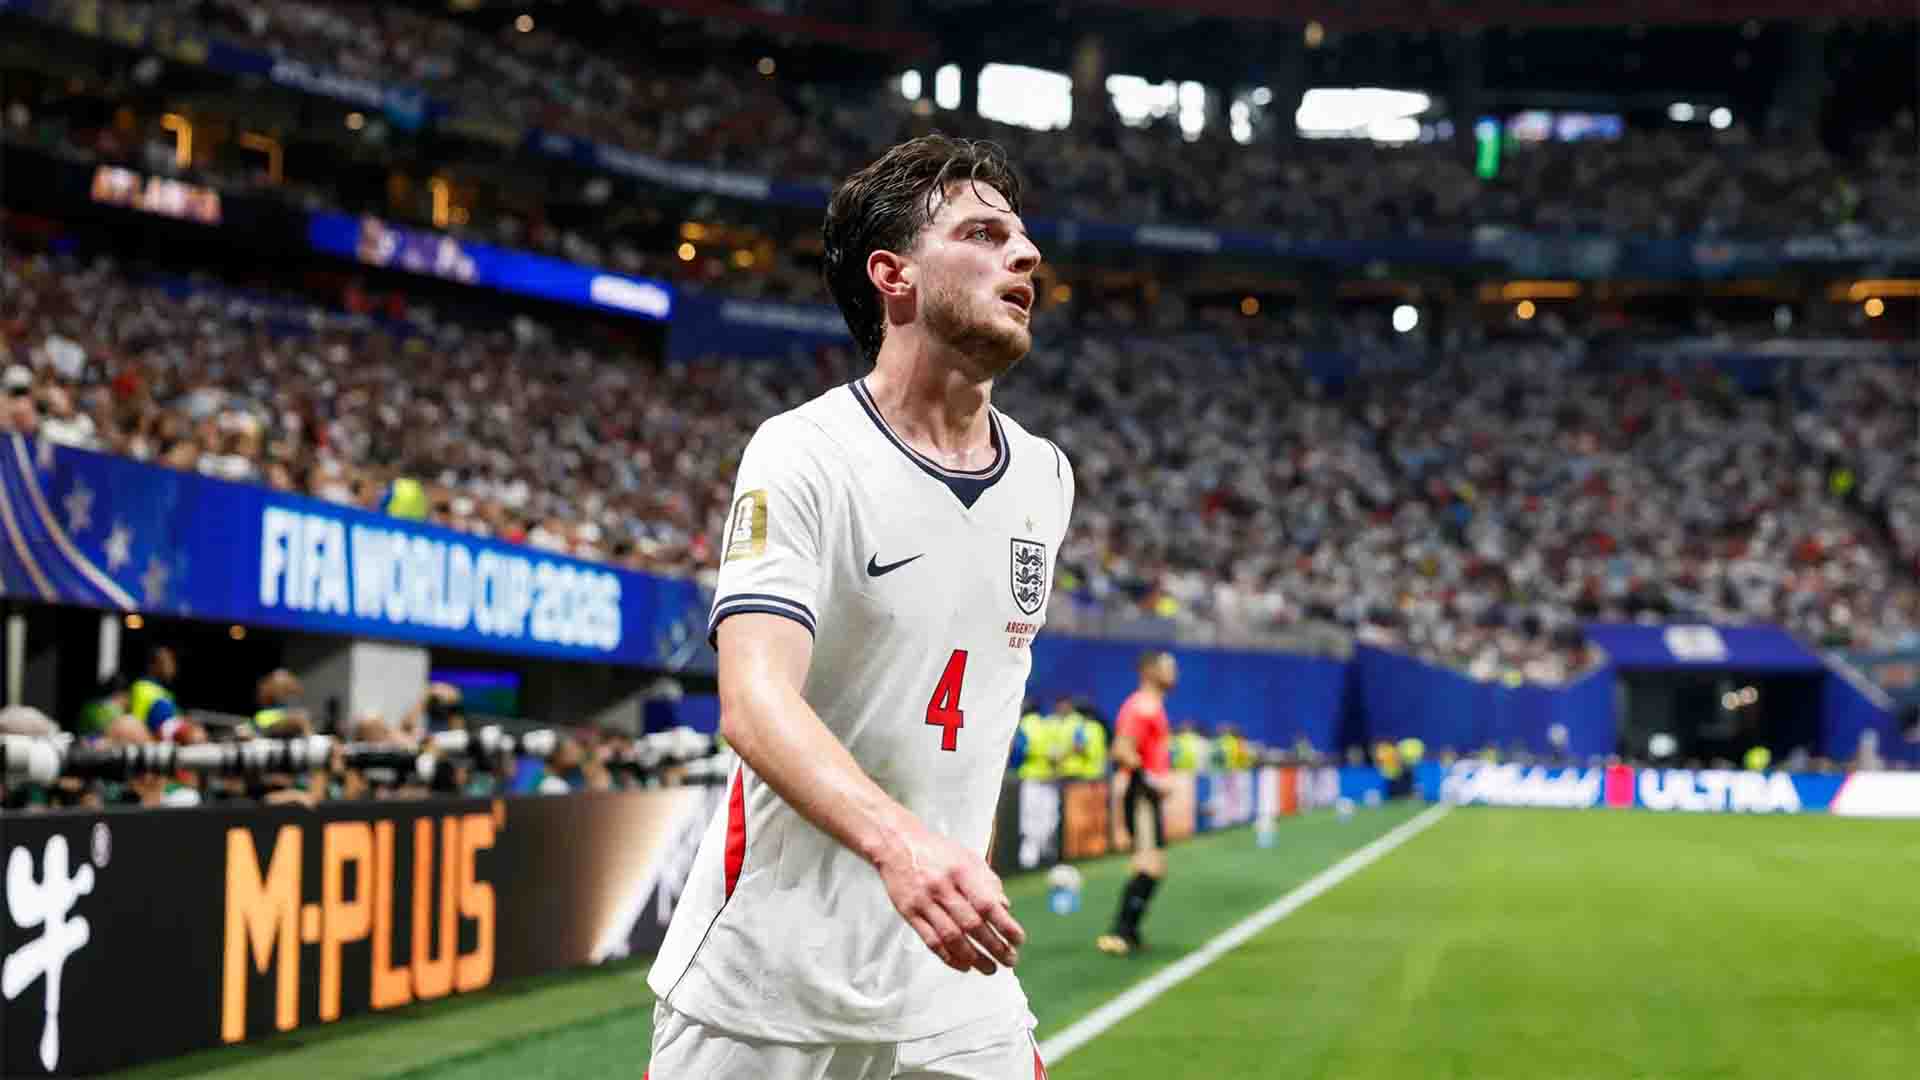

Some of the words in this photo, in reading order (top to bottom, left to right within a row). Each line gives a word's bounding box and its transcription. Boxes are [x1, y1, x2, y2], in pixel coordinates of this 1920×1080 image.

[260, 506, 349, 616] FIFA
[350, 524, 472, 629] WORLD
[474, 549, 532, 638] CUP
[530, 561, 621, 651] 2026
[925, 649, 968, 752] 4
[1638, 768, 1802, 812] ULTRA
